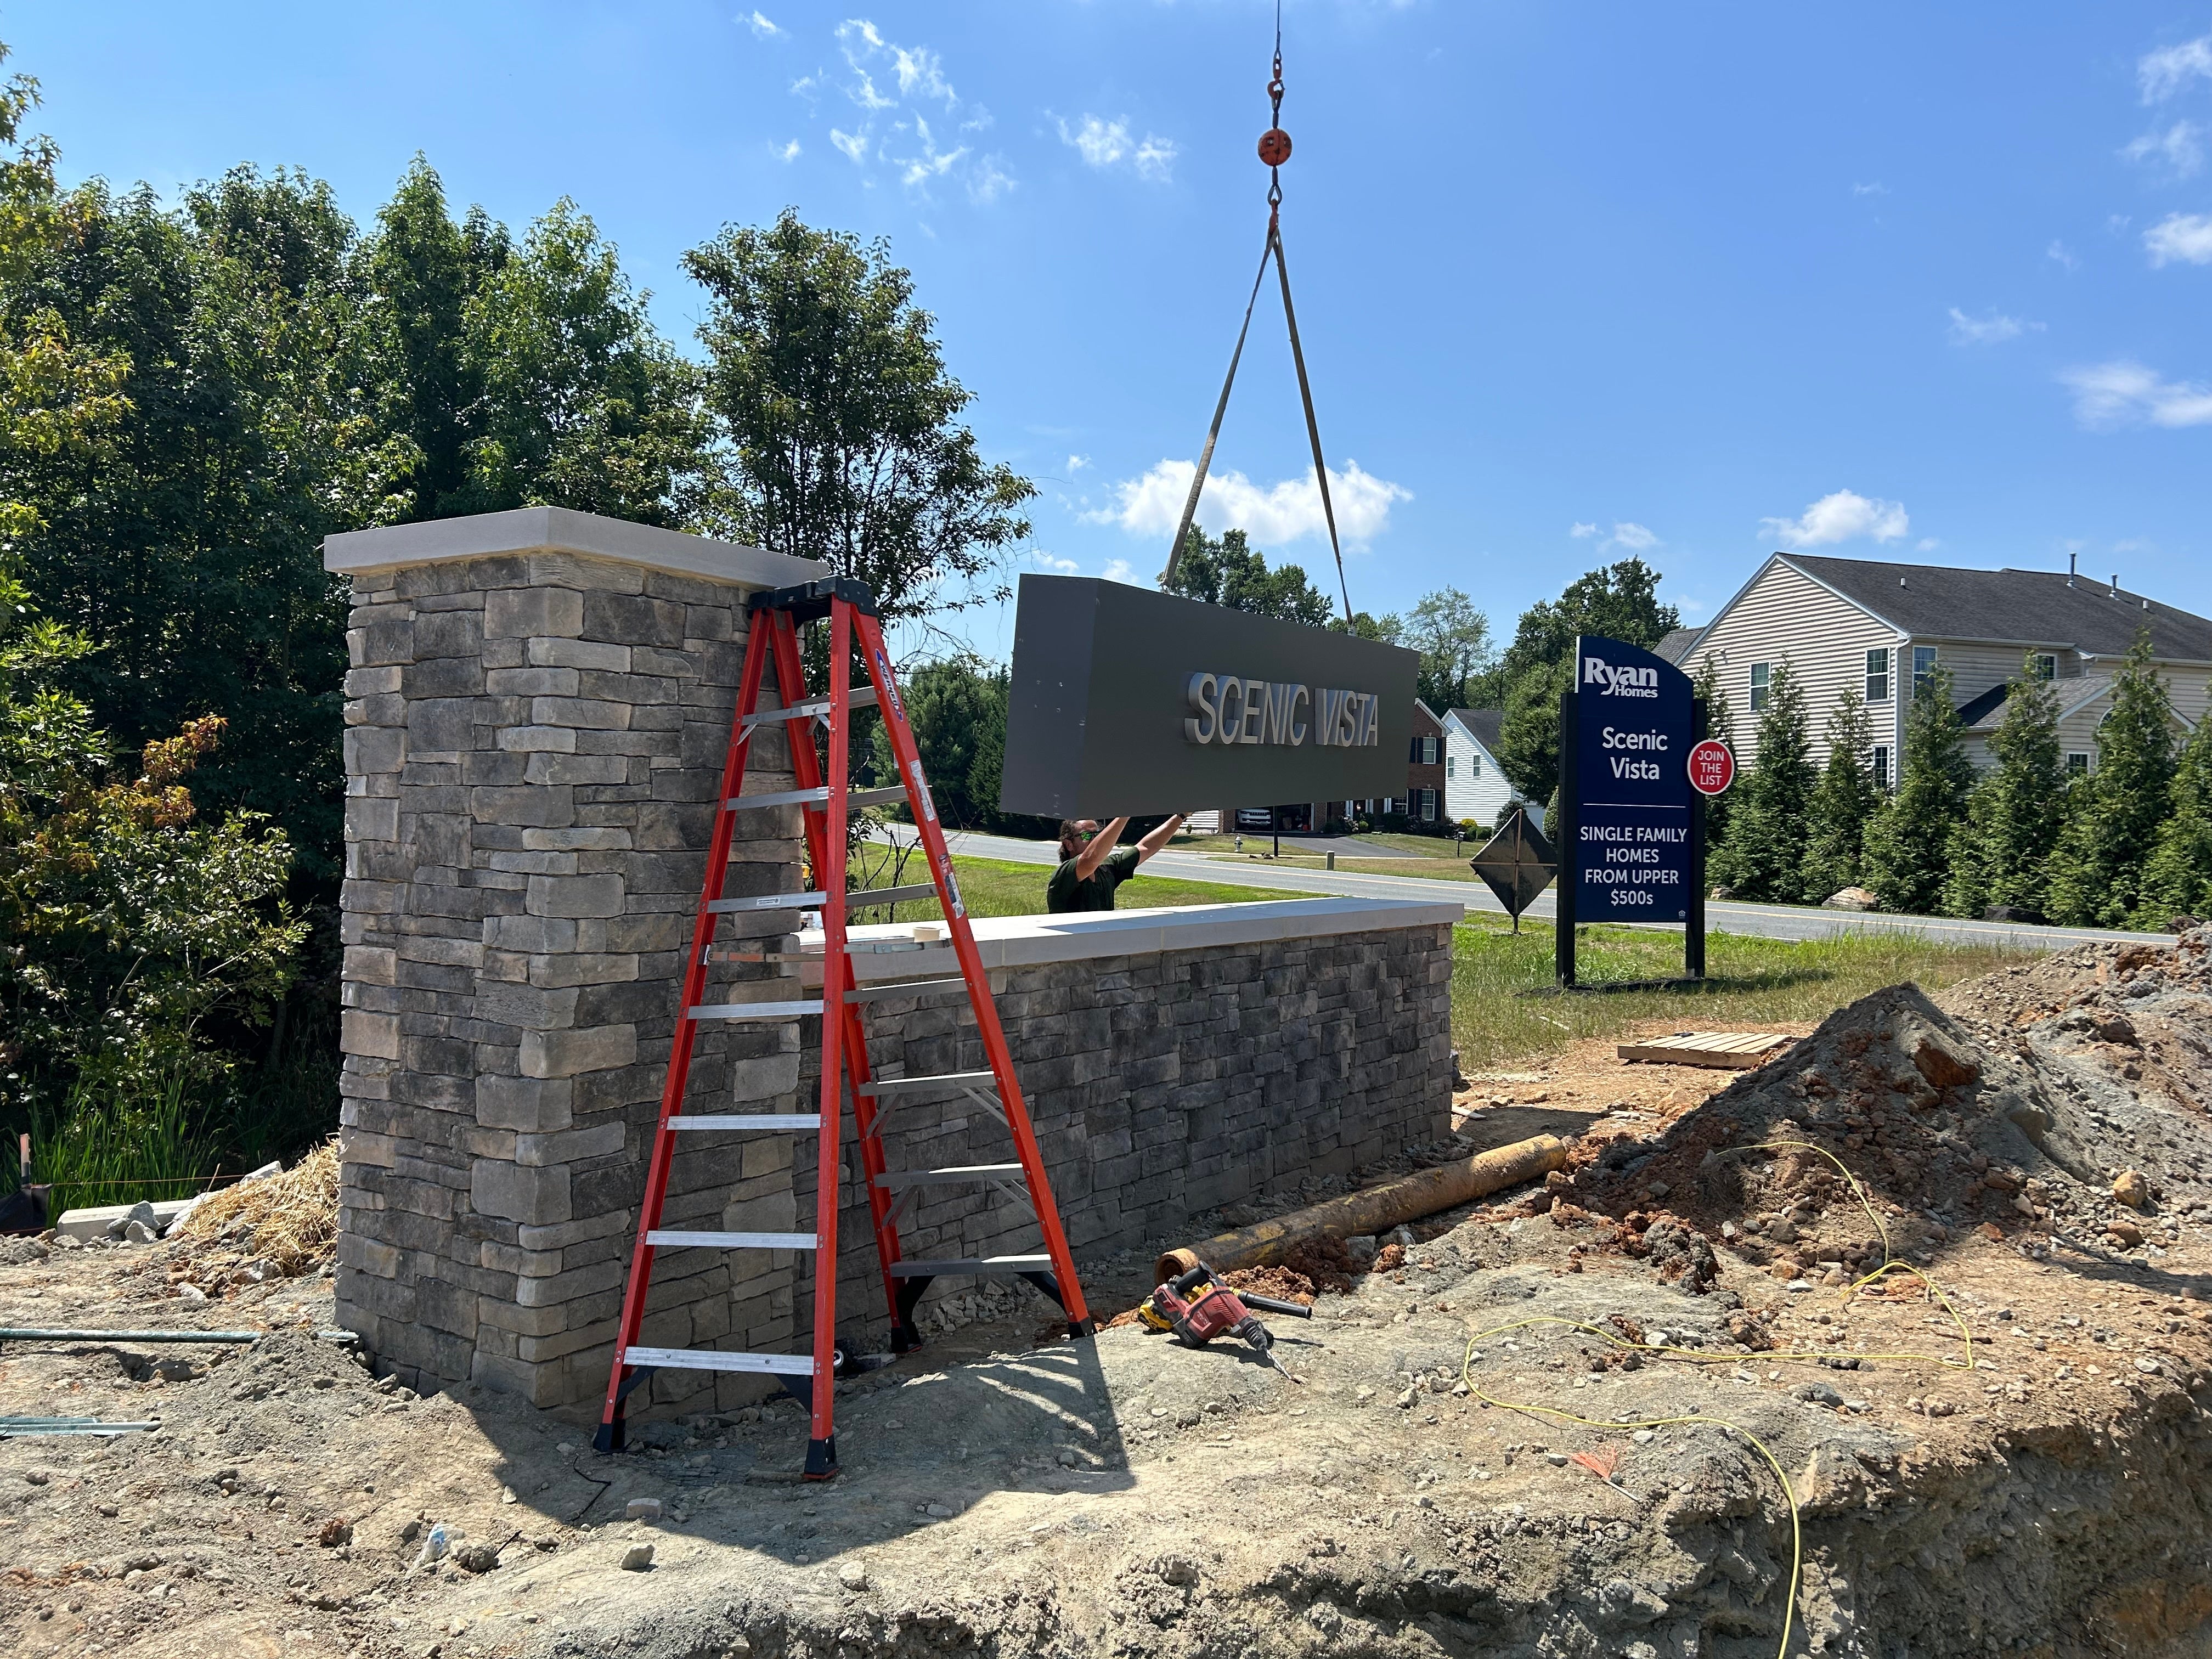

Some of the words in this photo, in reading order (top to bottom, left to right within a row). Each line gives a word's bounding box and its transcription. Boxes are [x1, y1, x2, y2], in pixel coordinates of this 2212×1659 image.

[1584, 657, 1658, 695] Ryan
[1615, 685, 1658, 698] Homes
[1185, 672, 1309, 747] SCENIC
[1315, 688, 1378, 747] VISTA
[1602, 726, 1668, 751] Scenic
[1697, 750, 1725, 761] JOIN
[1610, 757, 1660, 780] Vista
[1700, 762, 1722, 774] THE
[1700, 774, 1723, 786] LIST
[1580, 826, 1633, 841] SINGLE
[1637, 827, 1688, 842] FAMILY
[1606, 848, 1660, 863] HOMES
[1585, 869, 1628, 883] FROM
[1632, 870, 1679, 884] UPPER
[1610, 888, 1654, 906] $500s
